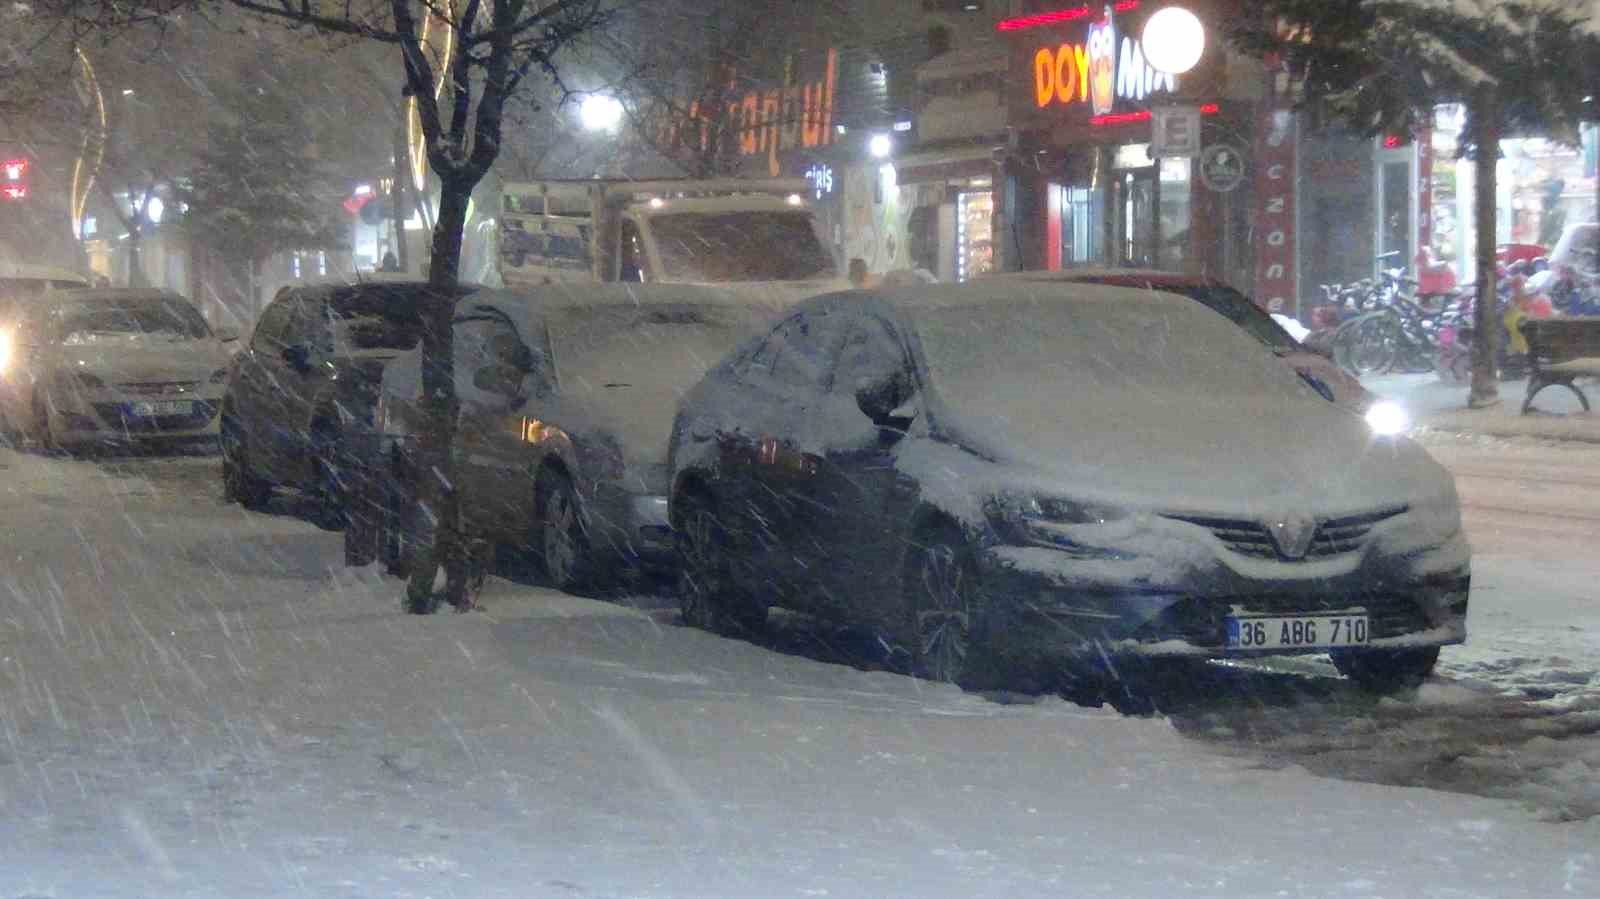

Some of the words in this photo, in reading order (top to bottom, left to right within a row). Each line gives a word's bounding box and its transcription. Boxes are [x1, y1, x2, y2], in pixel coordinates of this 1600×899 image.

[1034, 43, 1090, 108] DOY
[1241, 621, 1266, 646] 36
[1280, 620, 1316, 645] ABG
[1329, 618, 1366, 643] 710
